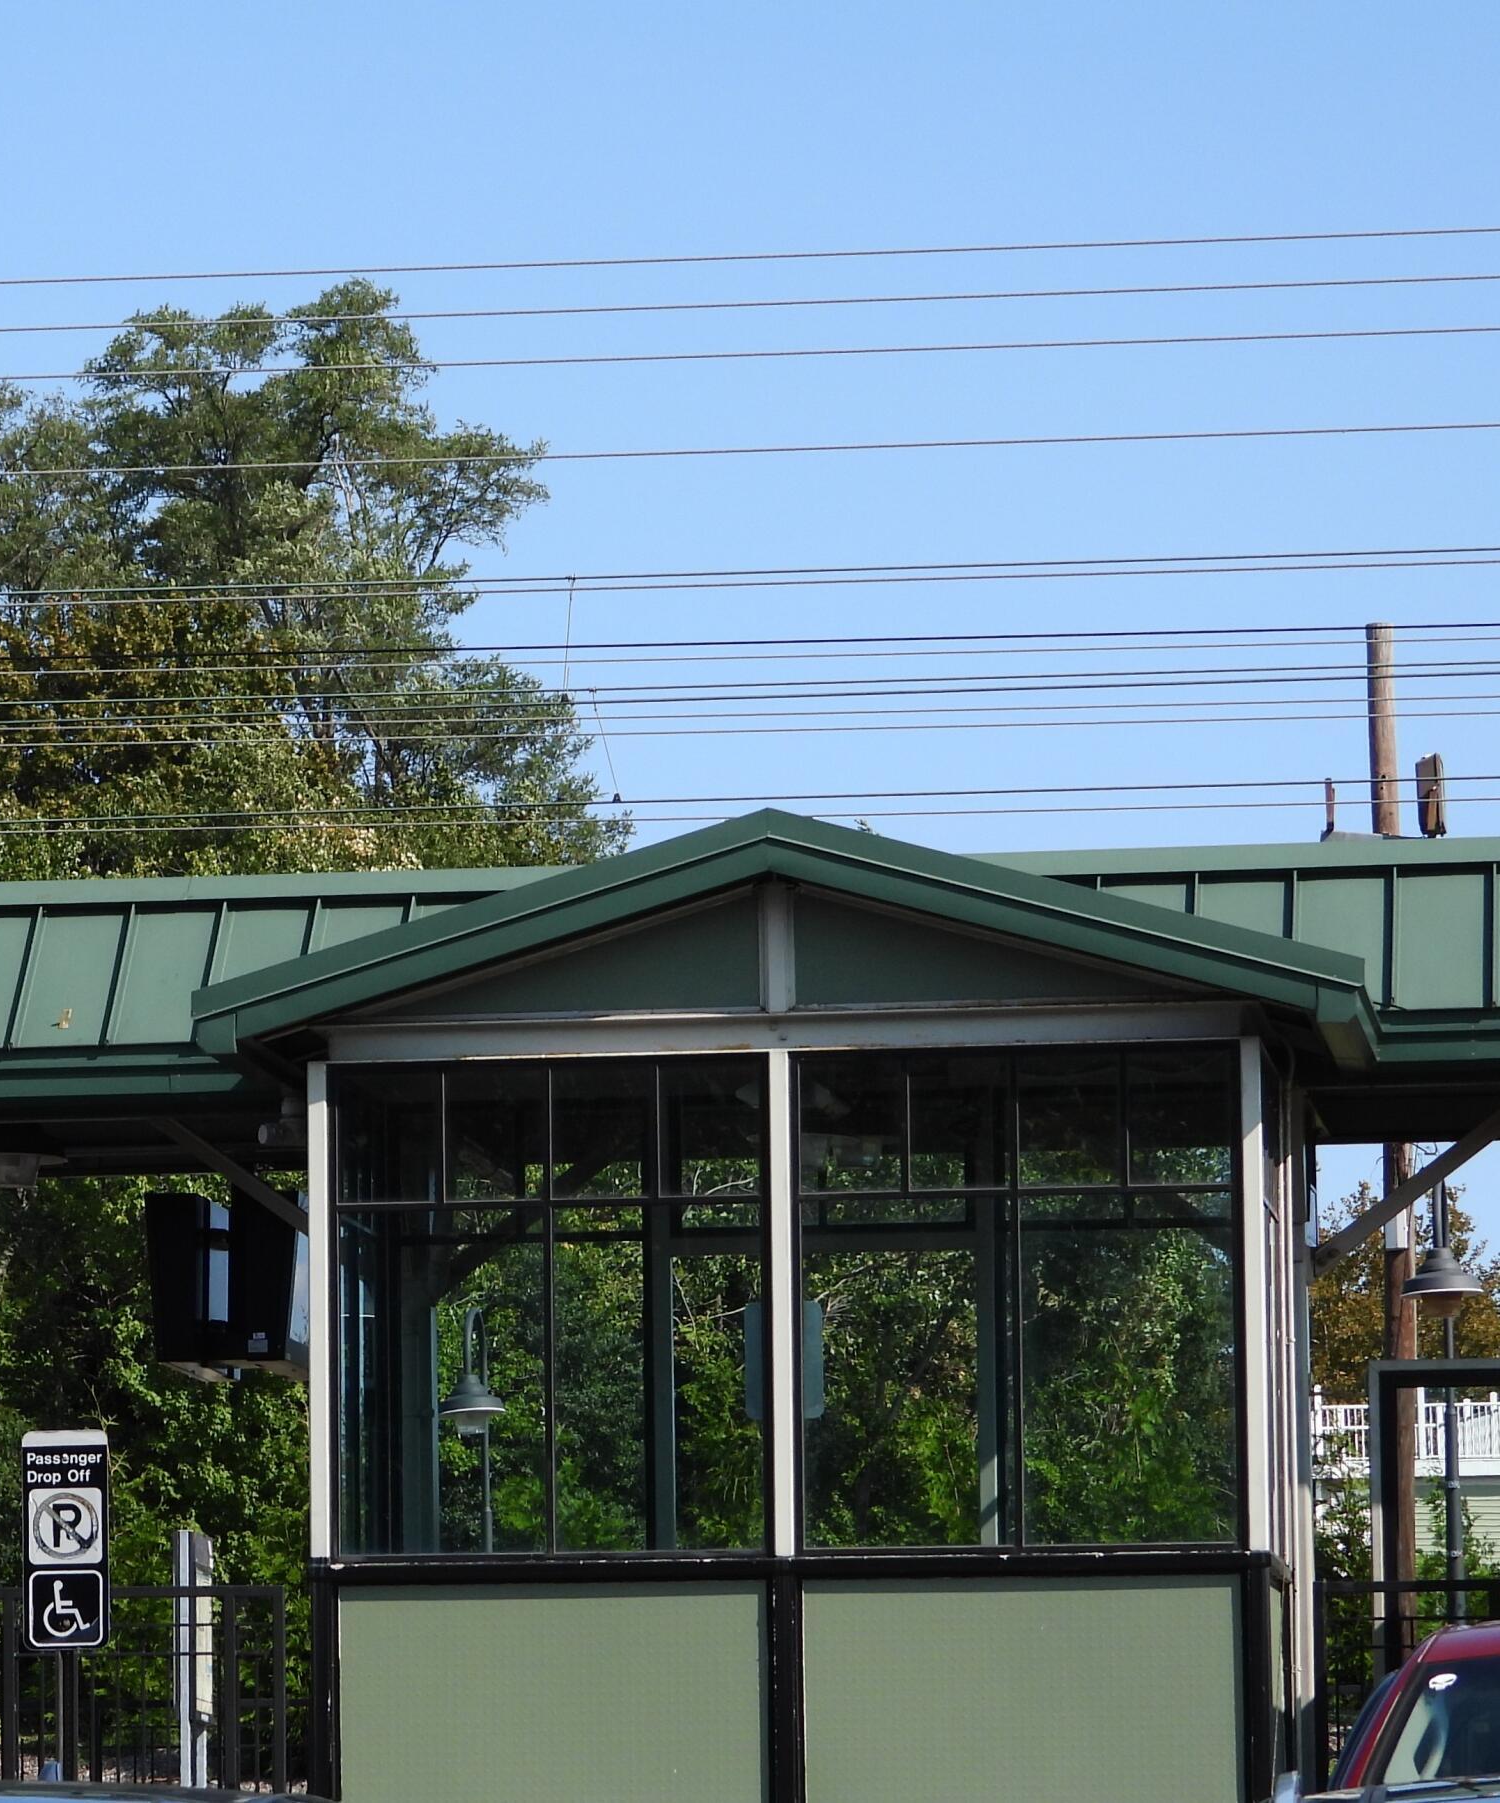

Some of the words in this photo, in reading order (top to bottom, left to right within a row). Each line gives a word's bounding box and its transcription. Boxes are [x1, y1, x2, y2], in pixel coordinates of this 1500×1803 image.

[26, 1452, 102, 1466] Passenger
[27, 1469, 61, 1485] Drop
[68, 1469, 91, 1482] Off
